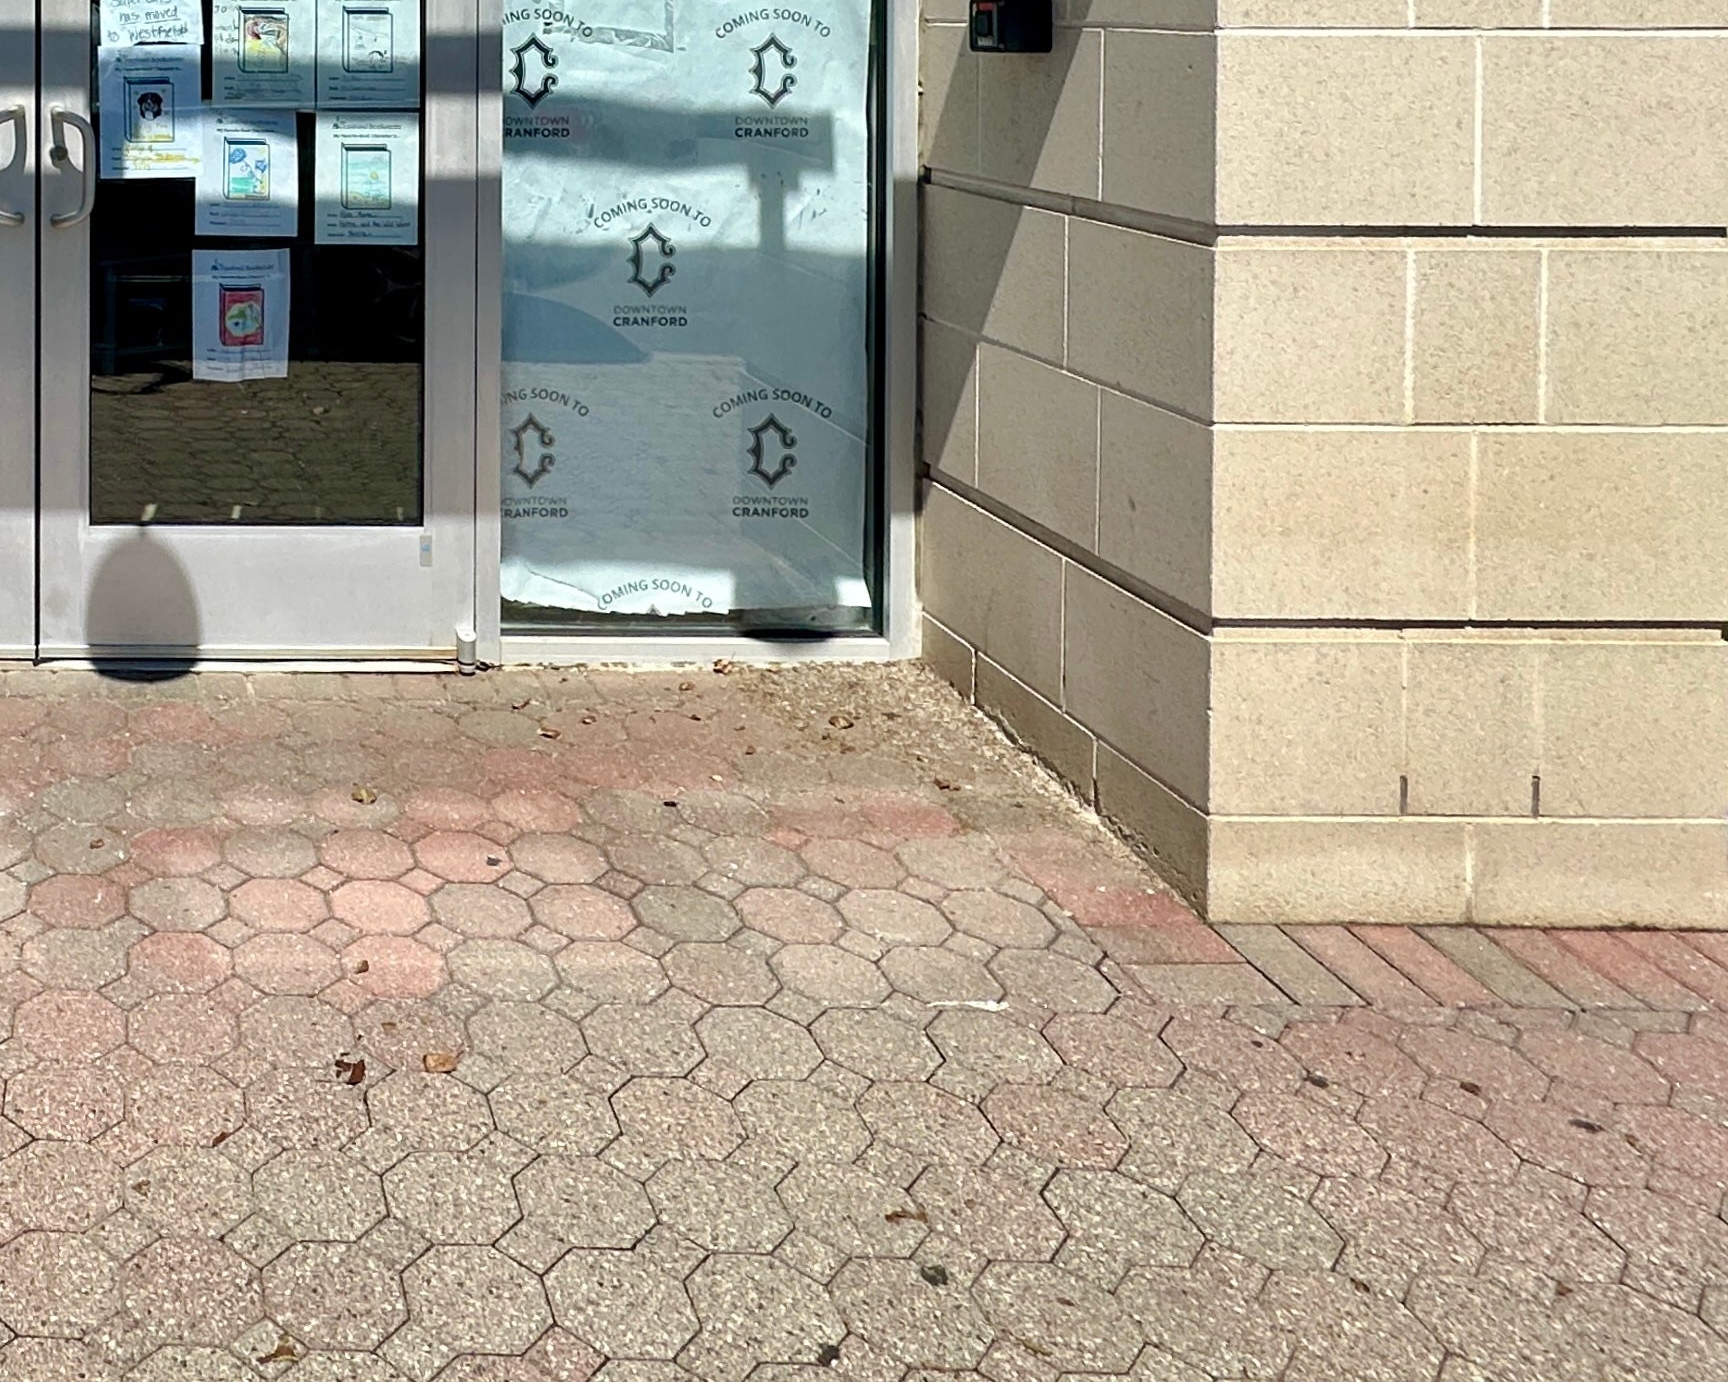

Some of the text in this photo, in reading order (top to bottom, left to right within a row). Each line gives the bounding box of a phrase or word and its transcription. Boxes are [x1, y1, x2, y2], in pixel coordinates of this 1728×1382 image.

[145, 5, 178, 20] moved
[534, 9, 574, 27] SOON
[576, 20, 592, 37] TO
[715, 9, 831, 39] COMING SOON TO
[505, 116, 569, 126] OWNTOWN
[735, 116, 808, 125] DOWNTOWN
[504, 128, 570, 138] RANFORD
[735, 127, 809, 138] CRANFORD
[594, 198, 711, 229] COMING SOON TO
[613, 305, 687, 315] DOWNTOWN
[613, 316, 688, 327] CRANFORD
[531, 387, 570, 406] SOON
[572, 399, 589, 417] TO
[712, 389, 832, 419] COMING SOON TO
[502, 497, 567, 507] OWNTOWN
[732, 496, 809, 506] DOWNTOWN
[501, 508, 569, 519] RANFORD
[732, 507, 809, 518] CRANFORD
[652, 579, 692, 597] SOON
[696, 591, 713, 608] TO
